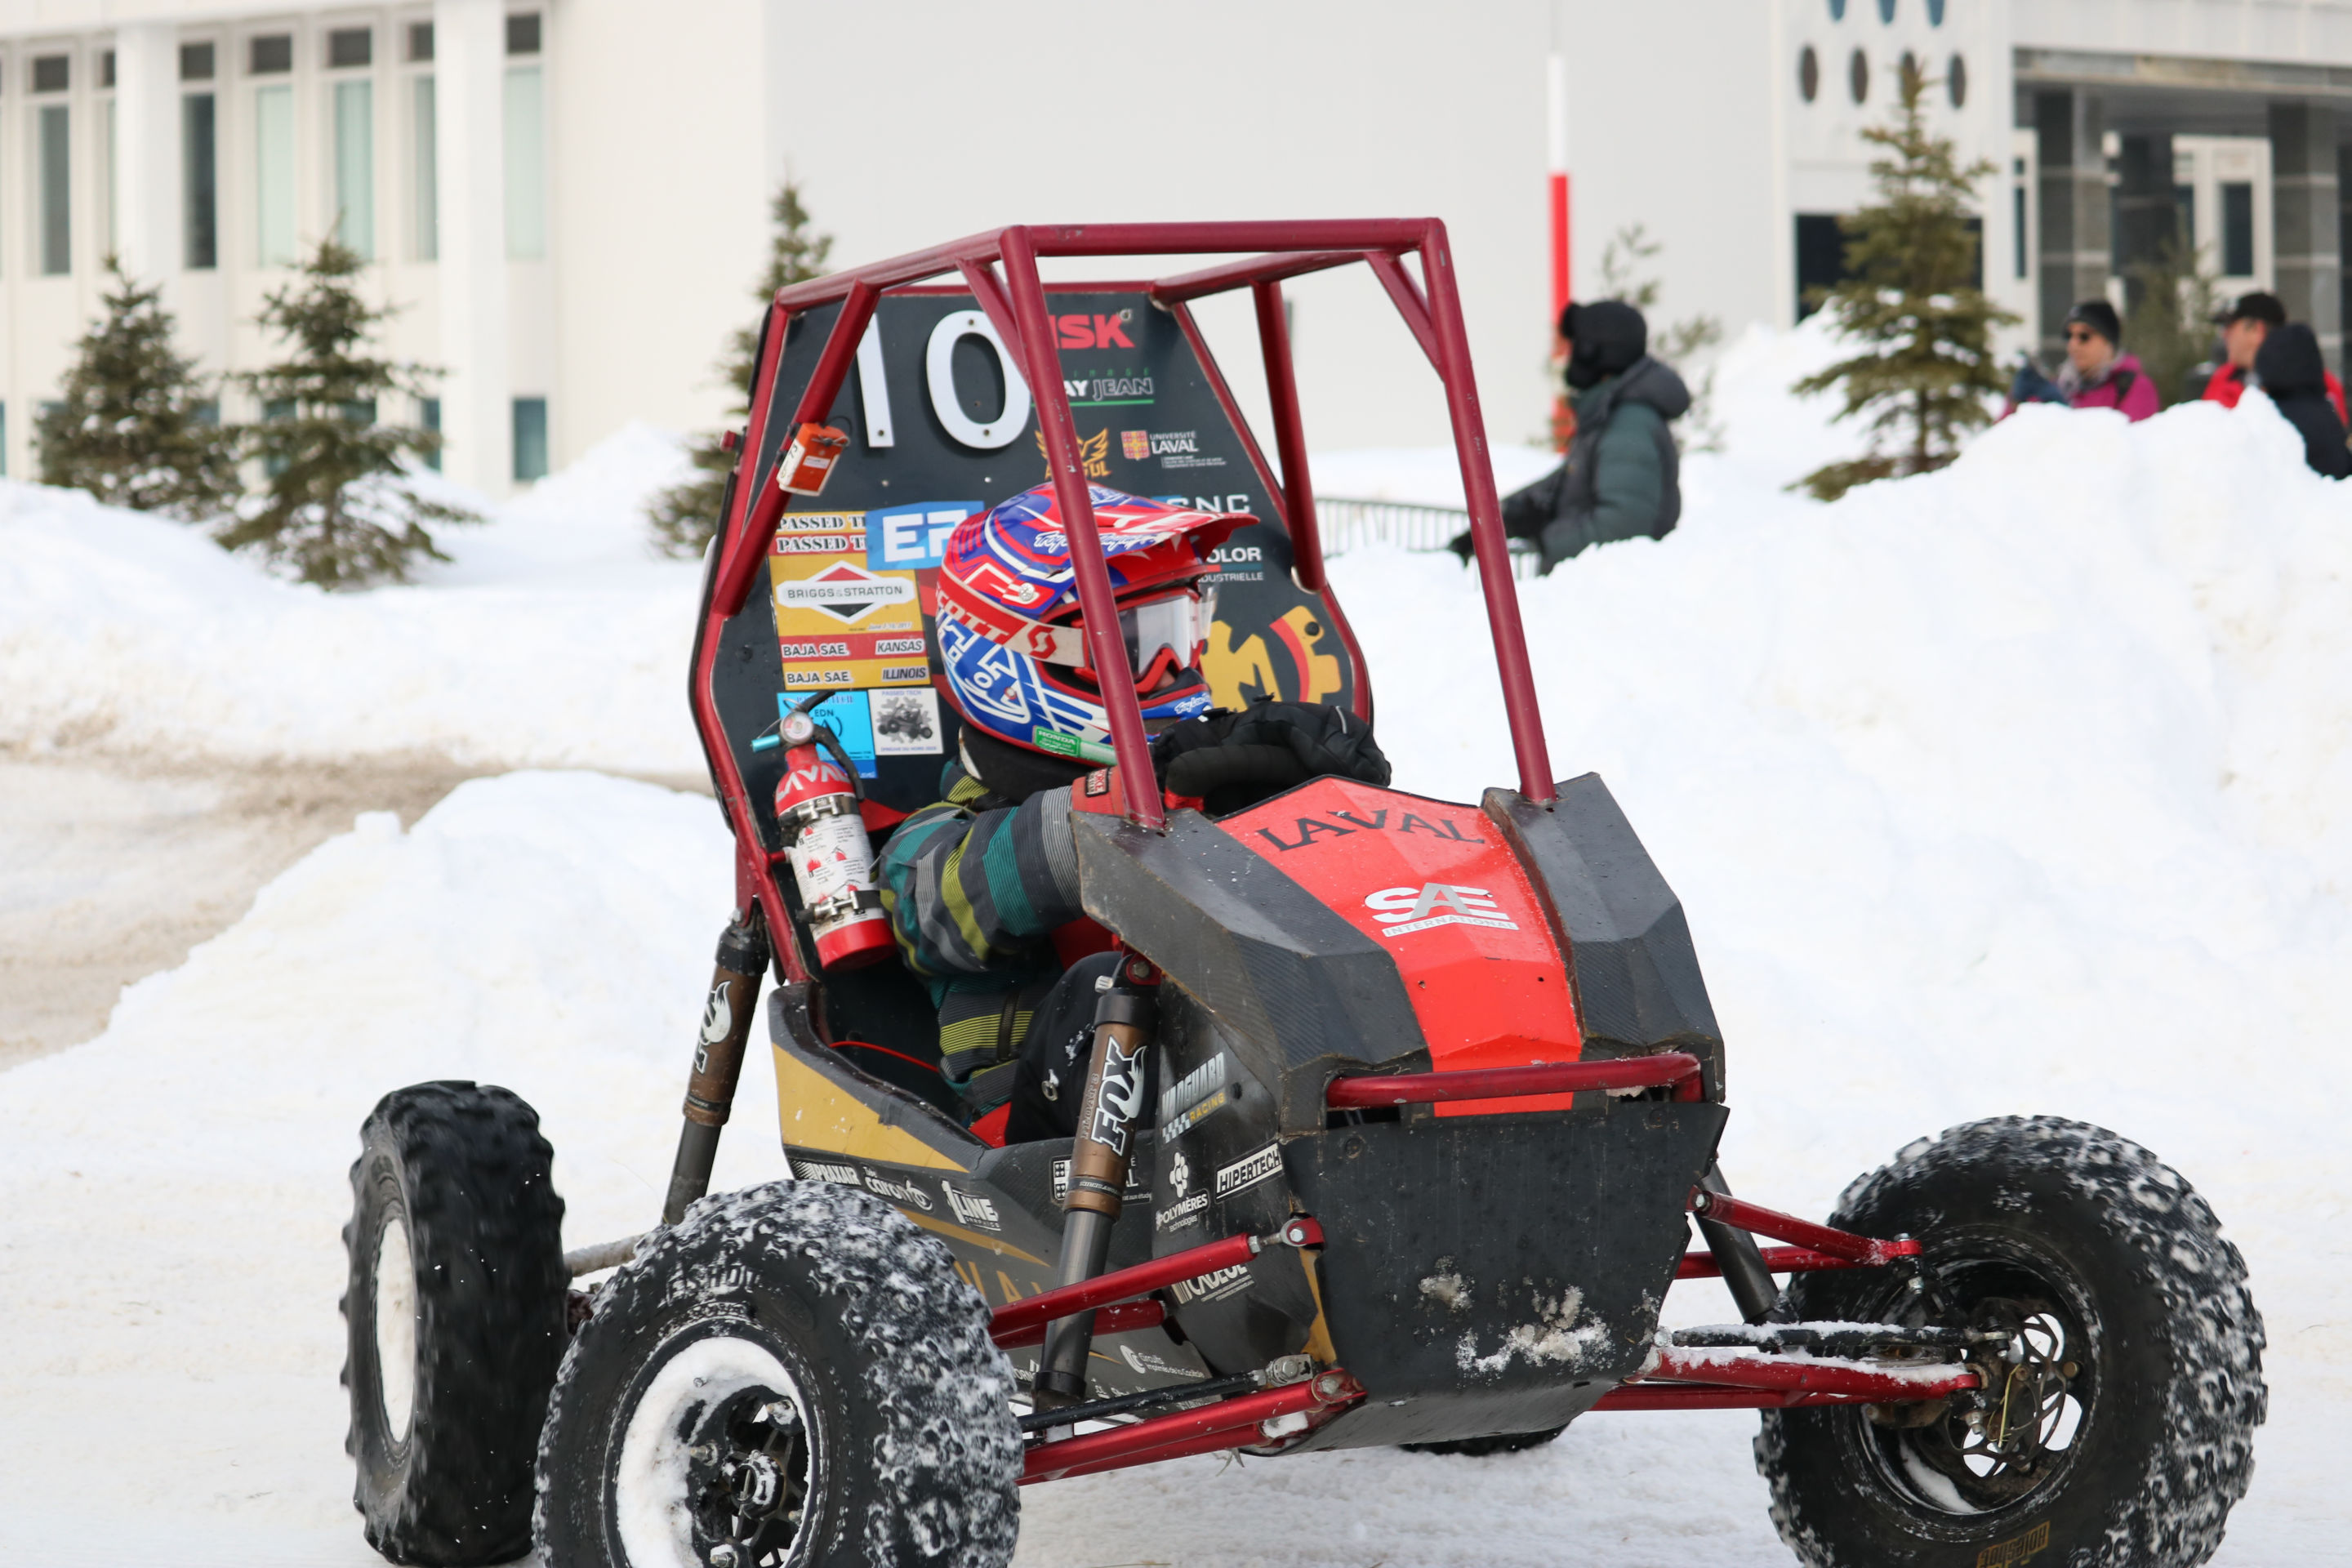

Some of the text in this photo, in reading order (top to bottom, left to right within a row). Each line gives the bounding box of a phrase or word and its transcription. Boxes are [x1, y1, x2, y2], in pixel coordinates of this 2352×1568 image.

[857, 310, 1031, 448] 10
[1093, 377, 1154, 401] JEAN
[1151, 439, 1200, 454] LAVAL
[777, 516, 844, 531] PASSED
[778, 536, 847, 552] PASSED
[1206, 547, 1262, 562] OLOR
[1198, 572, 1263, 582] DUSTRIELLE
[787, 588, 835, 599] BRIGGS
[844, 586, 902, 596] STRATTON
[783, 645, 816, 656] BAJA
[877, 640, 923, 653] KANSAS
[787, 672, 820, 684] BAJA
[882, 667, 927, 680] ILLINOIS
[1038, 730, 1076, 745] HONDA
[1256, 809, 1485, 852] LAVAL
[1365, 882, 1510, 923] SAE
[1385, 915, 1517, 937] INTERNATIONAL
[1091, 1035, 1140, 1156] FOX
[1162, 1052, 1224, 1121] VANGUARD
[1189, 1092, 1226, 1122] RACING
[813, 1163, 862, 1185] PRAXAIR
[1219, 1148, 1281, 1192] HIPERTECH
[1156, 1192, 1208, 1231] POLYMÈRES
[1169, 1214, 1198, 1233] technologies
